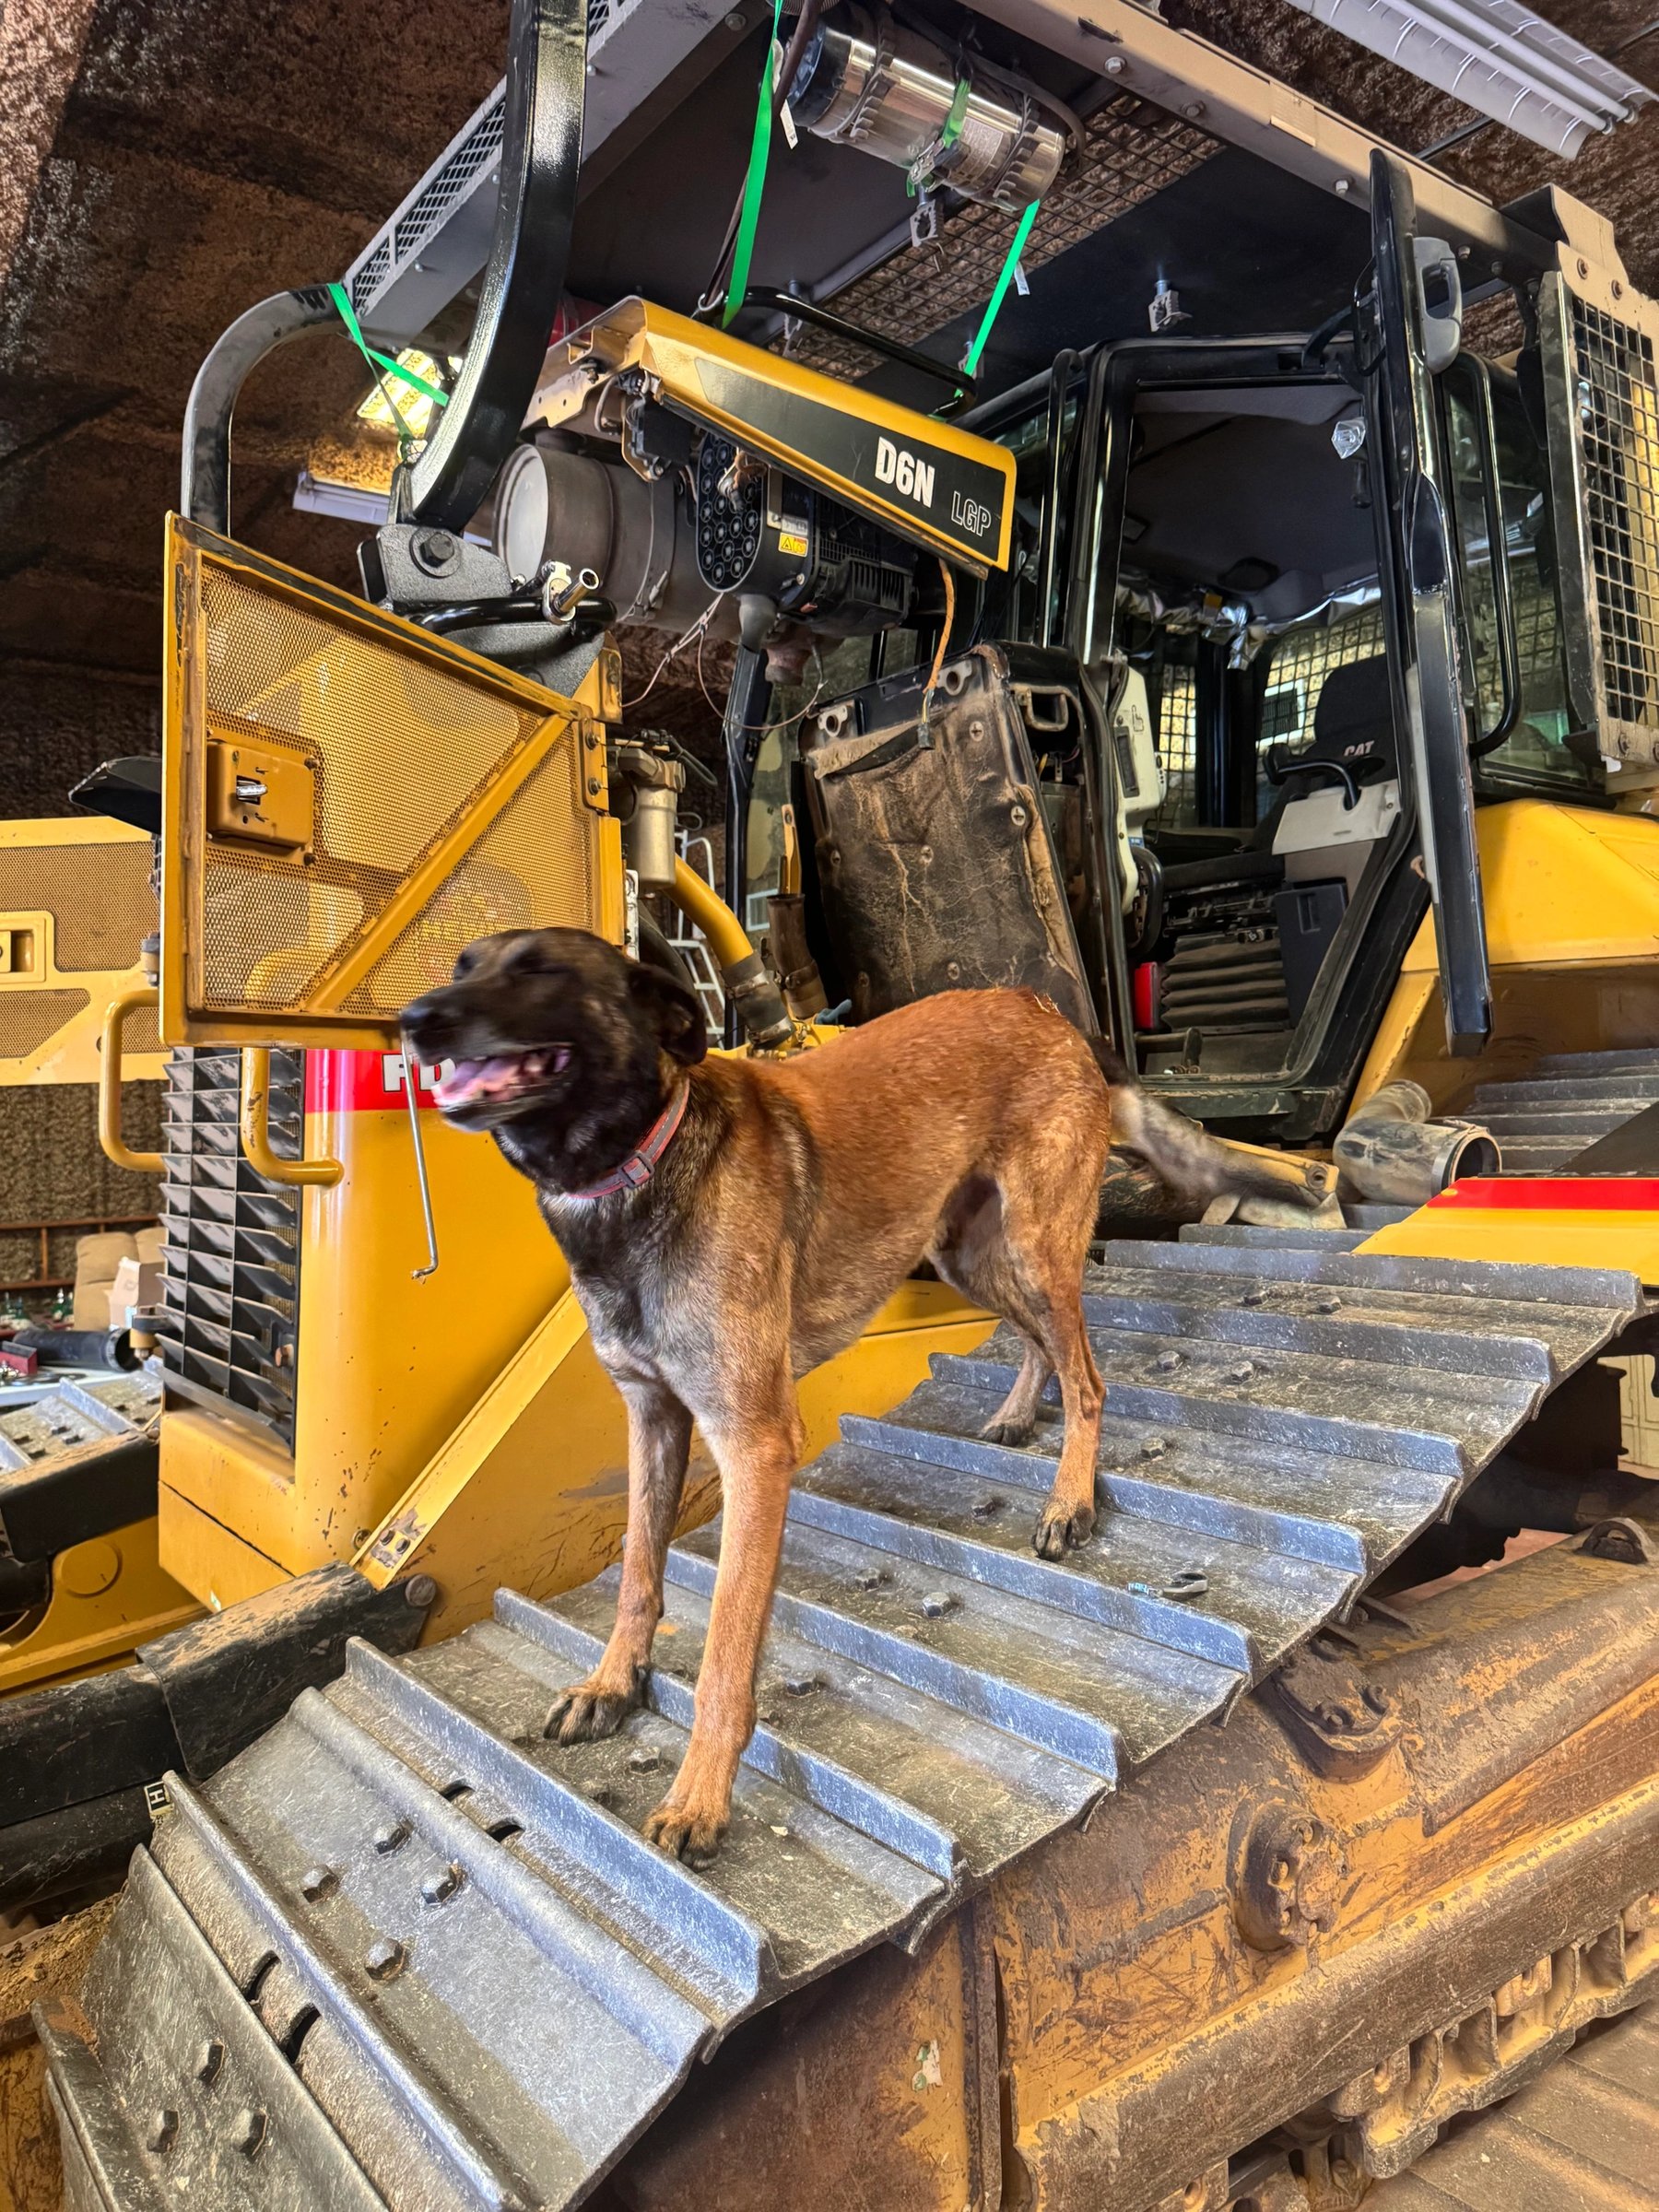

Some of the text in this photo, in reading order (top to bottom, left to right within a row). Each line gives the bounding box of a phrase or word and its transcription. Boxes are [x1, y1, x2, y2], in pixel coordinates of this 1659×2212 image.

[875, 436, 992, 537] D6N LGP
[1344, 741, 1375, 757] CAT
